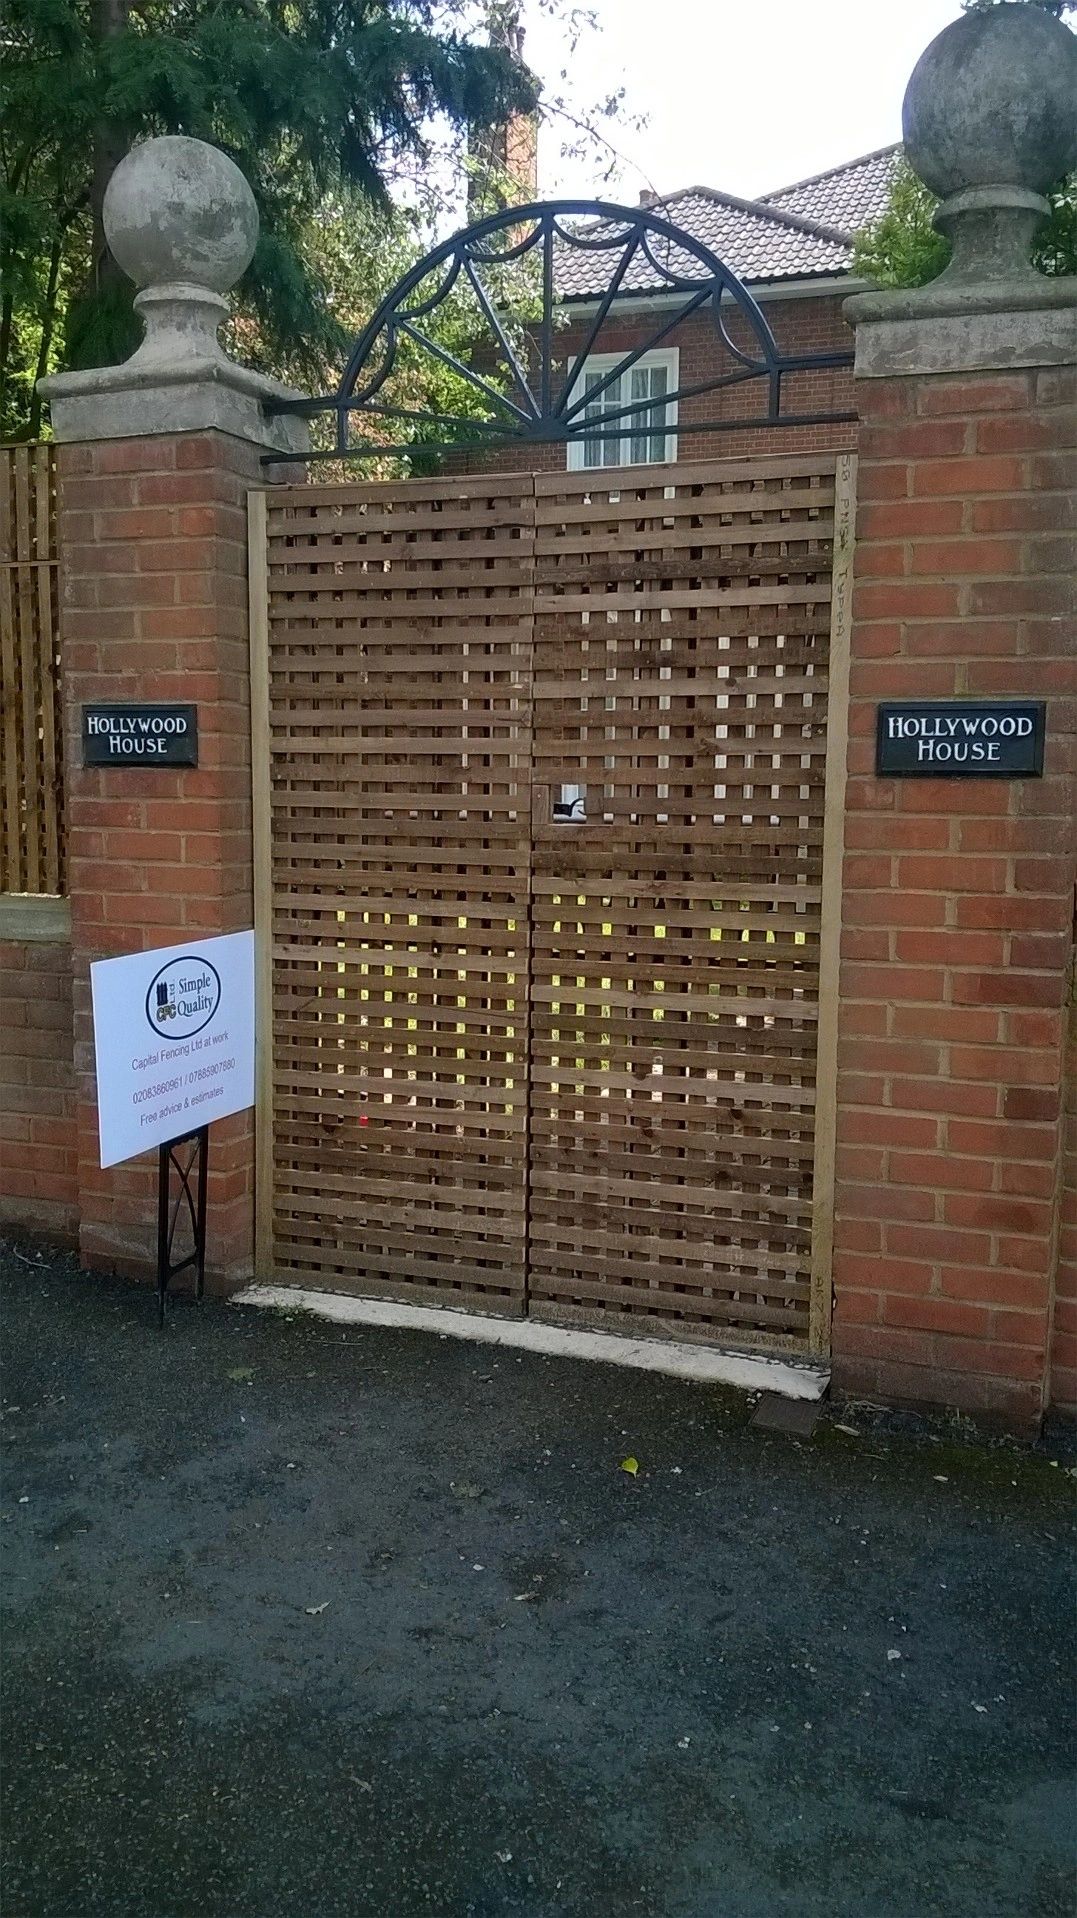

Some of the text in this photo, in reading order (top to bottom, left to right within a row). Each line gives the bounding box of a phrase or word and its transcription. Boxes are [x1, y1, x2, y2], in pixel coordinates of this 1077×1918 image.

[87, 716, 187, 734] HOLLYWOOD
[888, 717, 1033, 738] HOLLYWOOD
[109, 735, 168, 753] HOUSE
[917, 739, 1001, 761] HOUSE
[178, 972, 211, 995] Simple
[177, 995, 213, 1017] Quality
[131, 1051, 159, 1071] Capital
[160, 1044, 190, 1062] Fencing
[212, 1030, 229, 1045] work
[140, 1087, 224, 1127] Free advice & estimates
